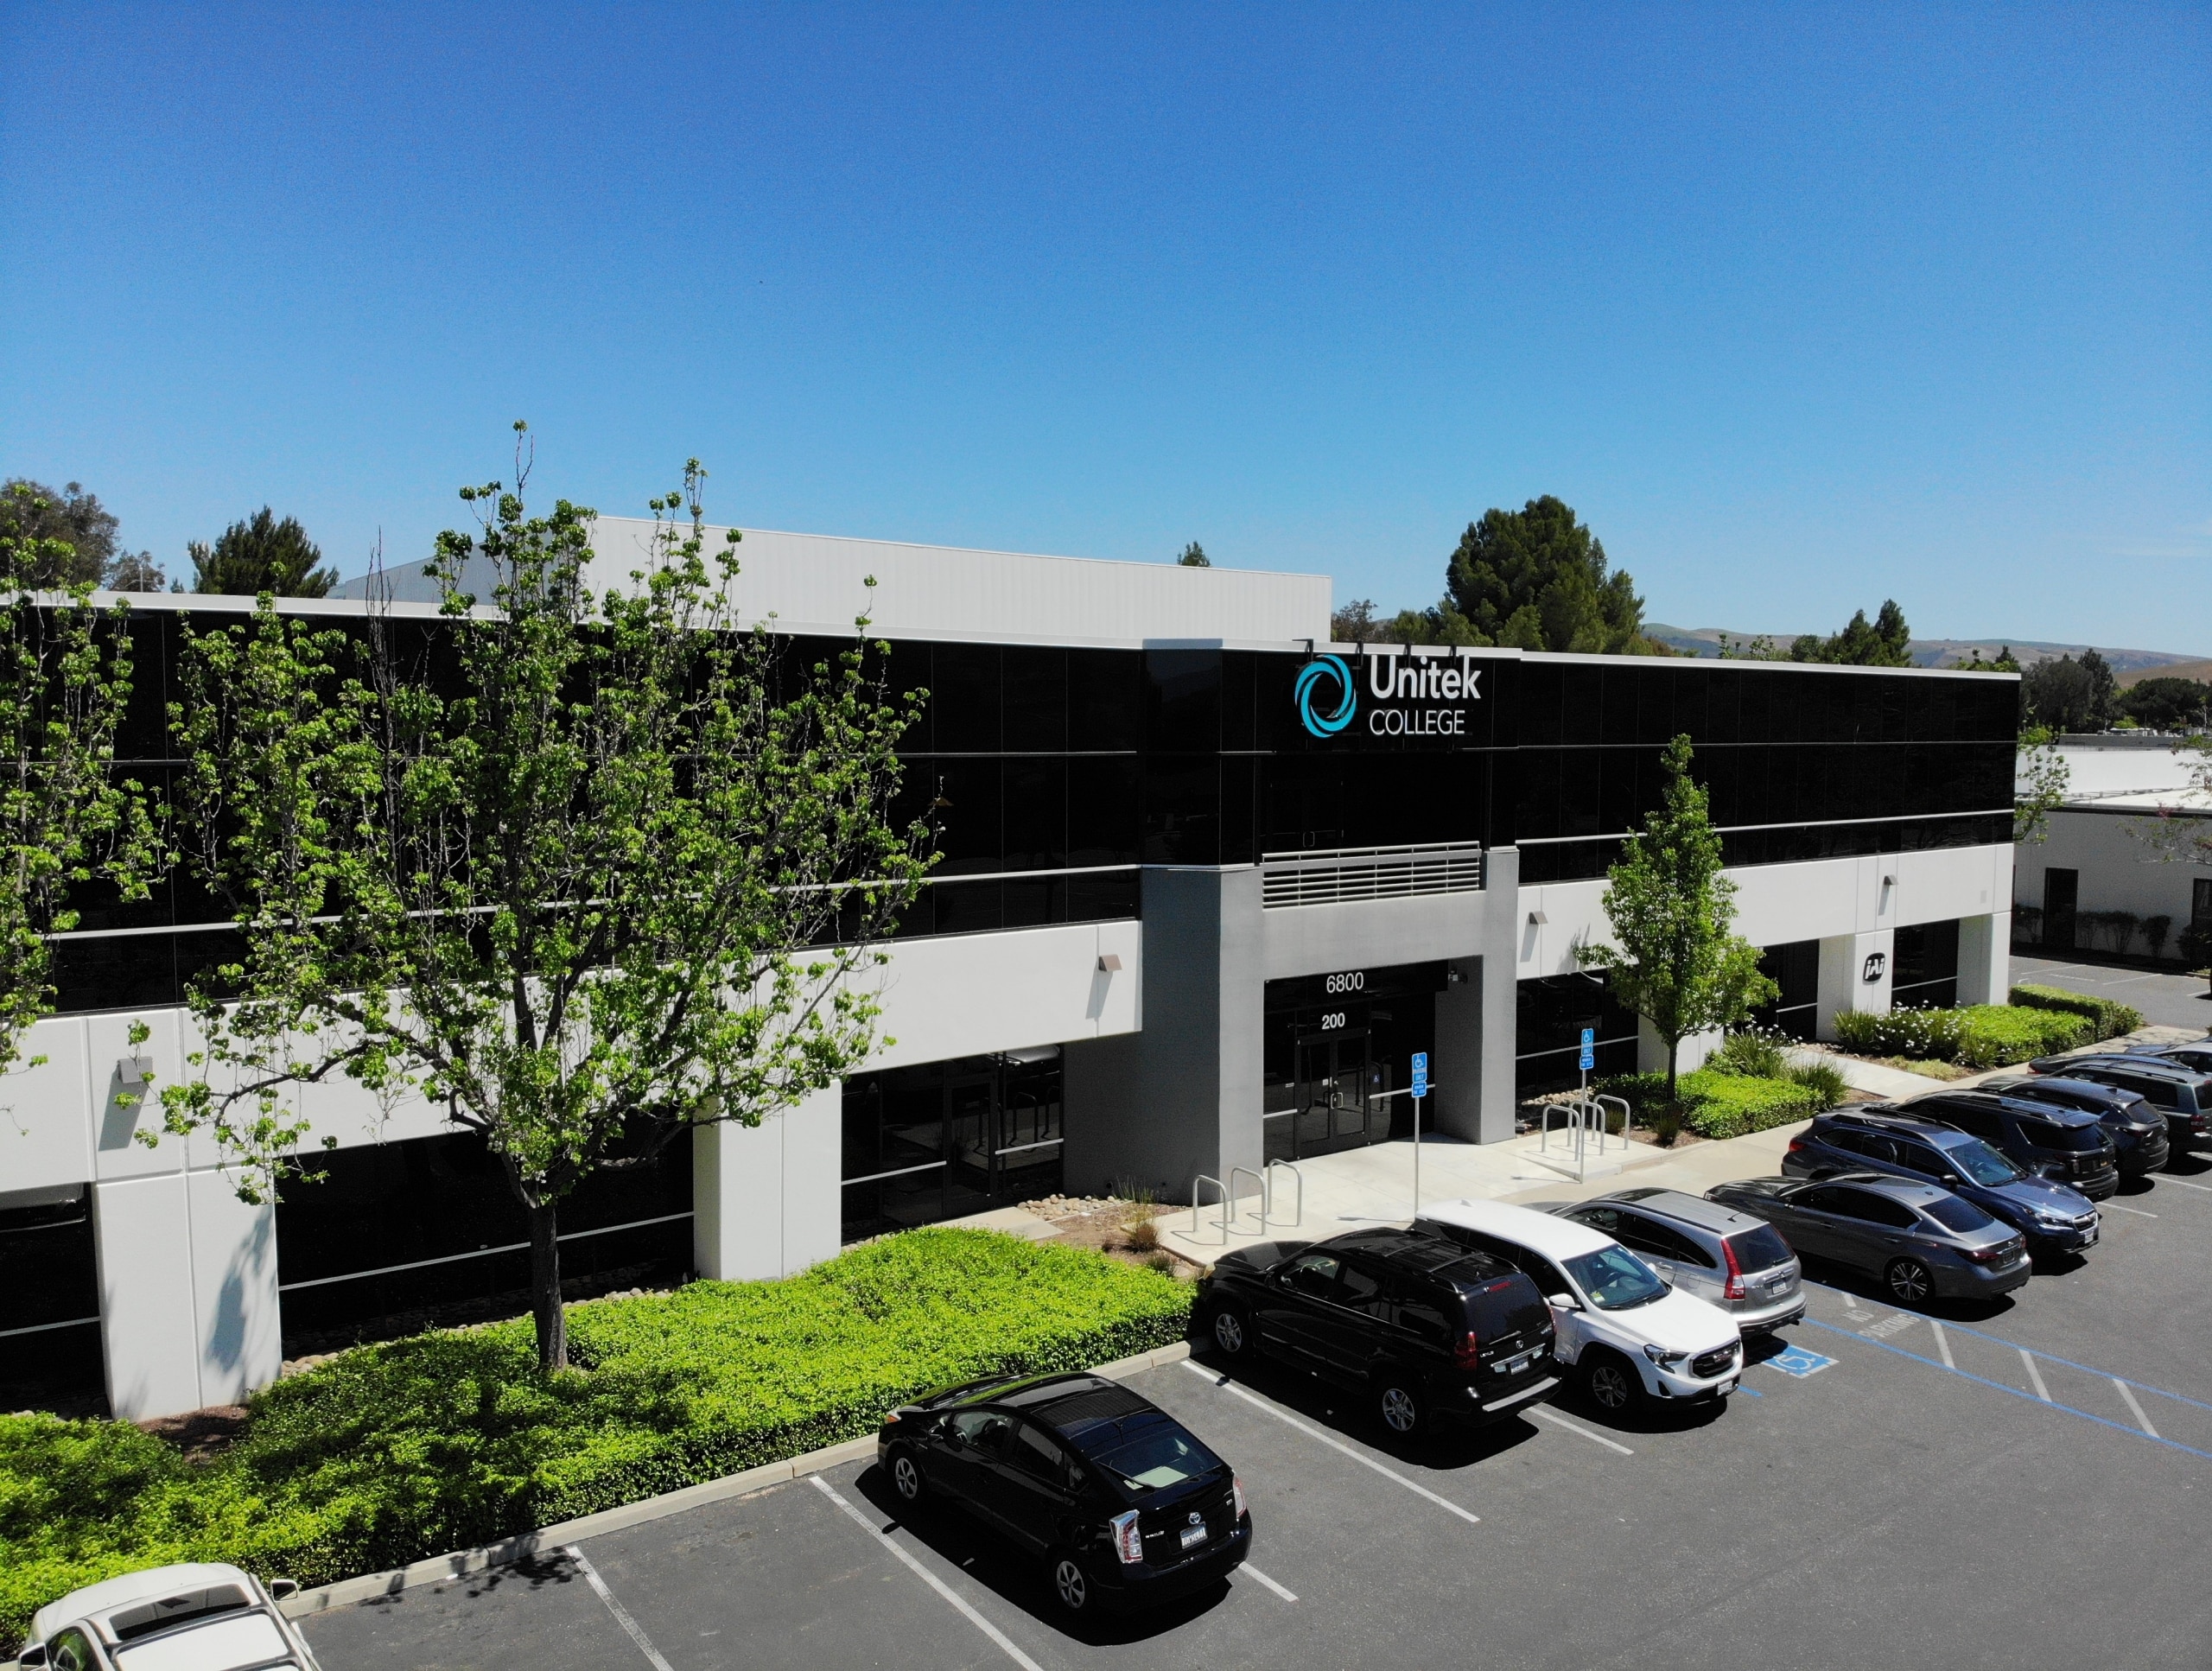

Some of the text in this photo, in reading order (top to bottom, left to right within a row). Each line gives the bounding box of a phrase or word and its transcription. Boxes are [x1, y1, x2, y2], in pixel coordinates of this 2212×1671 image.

[1370, 654, 1481, 699] Unitek
[1370, 709, 1465, 734] COLLEGE
[1326, 972, 1363, 993] 6800
[1321, 1013, 1345, 1029] 200
[1841, 1309, 1874, 1323] NO
